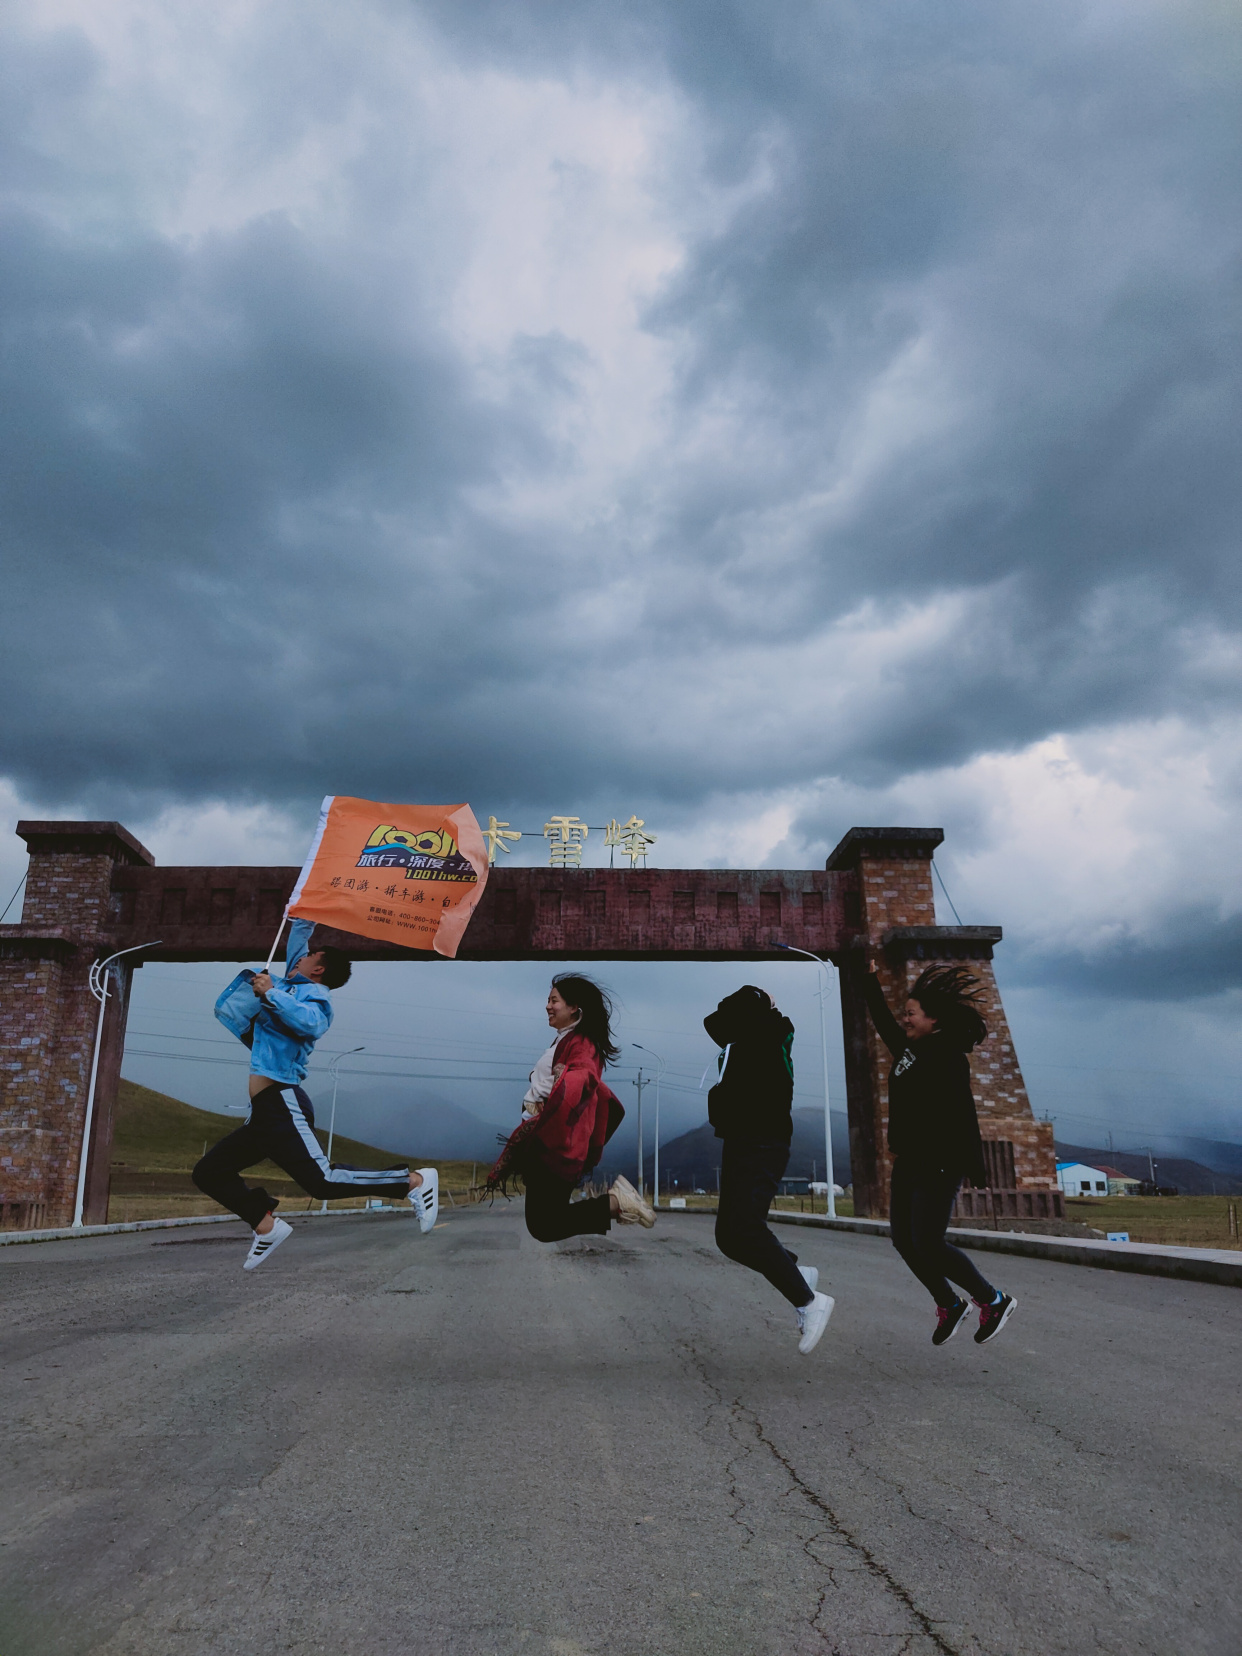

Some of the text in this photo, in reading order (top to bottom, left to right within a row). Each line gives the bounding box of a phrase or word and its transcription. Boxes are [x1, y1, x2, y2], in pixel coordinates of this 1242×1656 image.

[330, 876, 459, 907] 跟团游·拼车游·自
